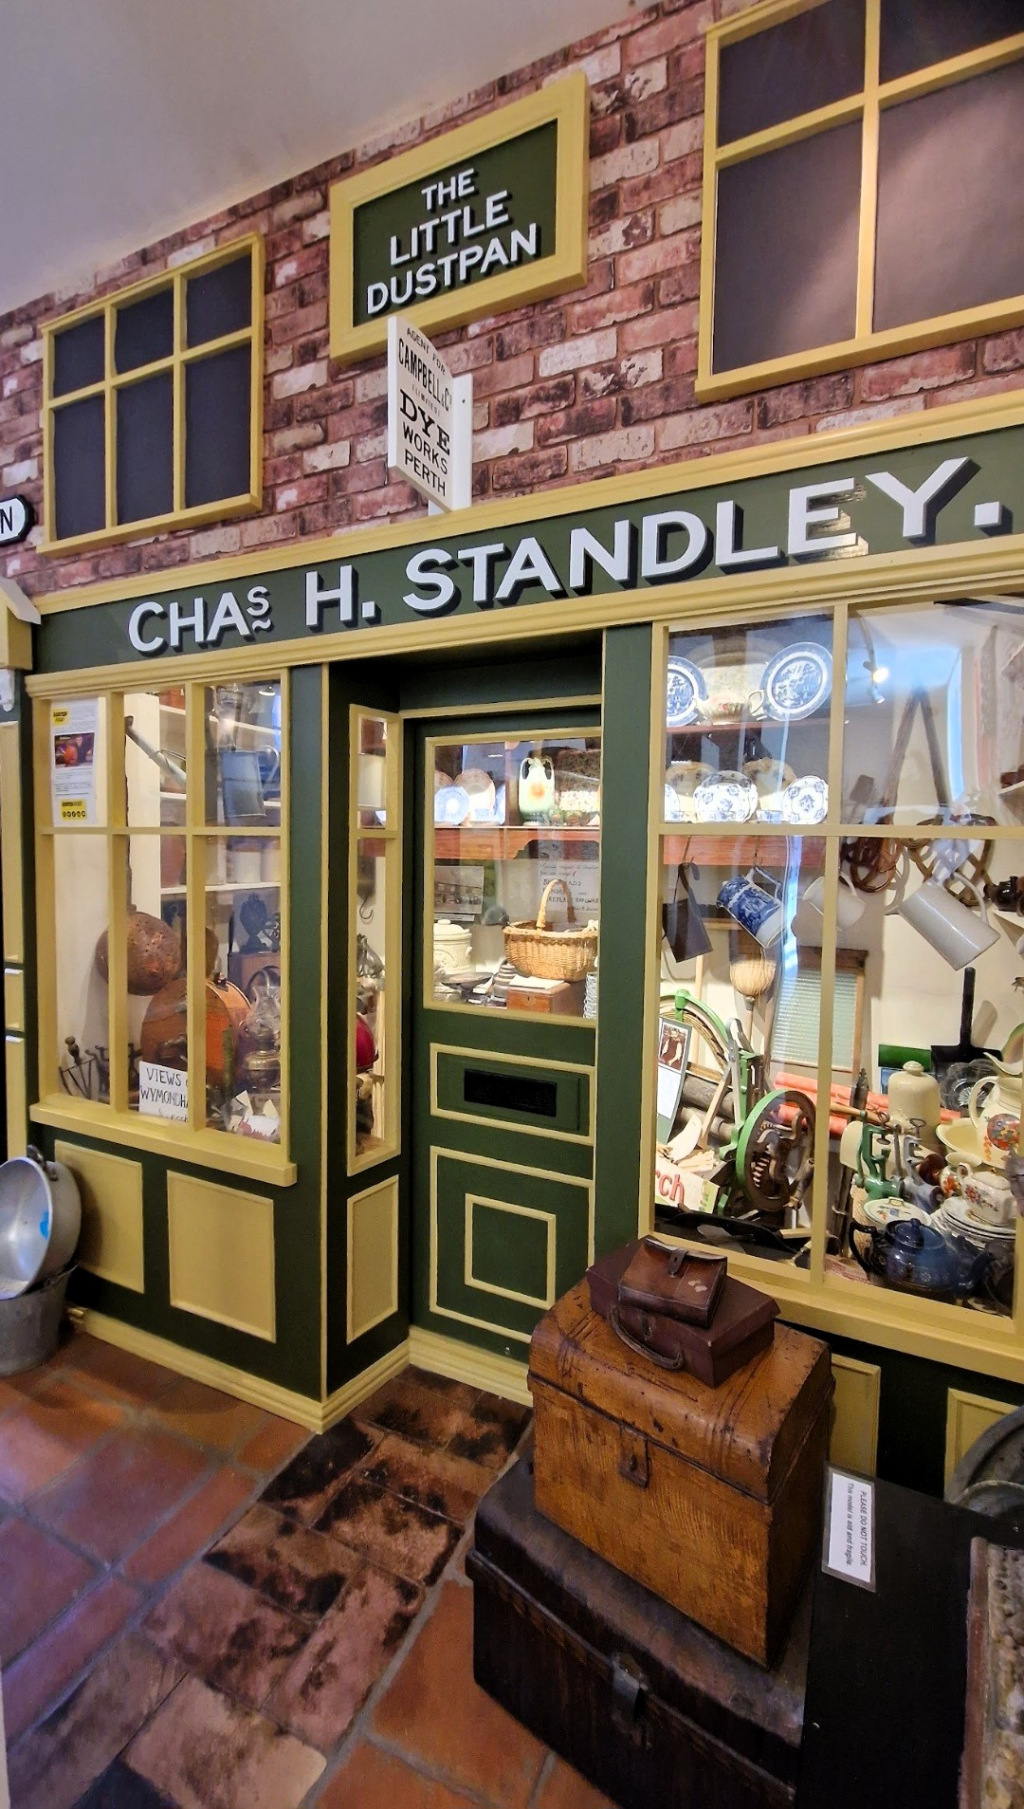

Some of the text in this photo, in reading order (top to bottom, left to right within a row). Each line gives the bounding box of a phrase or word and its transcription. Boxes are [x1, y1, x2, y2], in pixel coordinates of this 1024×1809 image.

[421, 168, 475, 211] THE
[390, 190, 509, 266] LITTLE
[367, 222, 537, 315] DUSTPAN
[406, 327, 446, 376] AGENT FOR
[399, 389, 451, 456] DYE
[402, 421, 448, 475] WORKS
[404, 448, 447, 497] PERTH
[305, 565, 377, 627] H.
[403, 457, 1001, 612] STANDLEY.
[146, 1067, 182, 1087] VIEWS
[847, 1482, 855, 1494] This
[860, 1490, 868, 1514] PLEASE
[860, 1515, 868, 1525] DO
[860, 1526, 868, 1540] NOT
